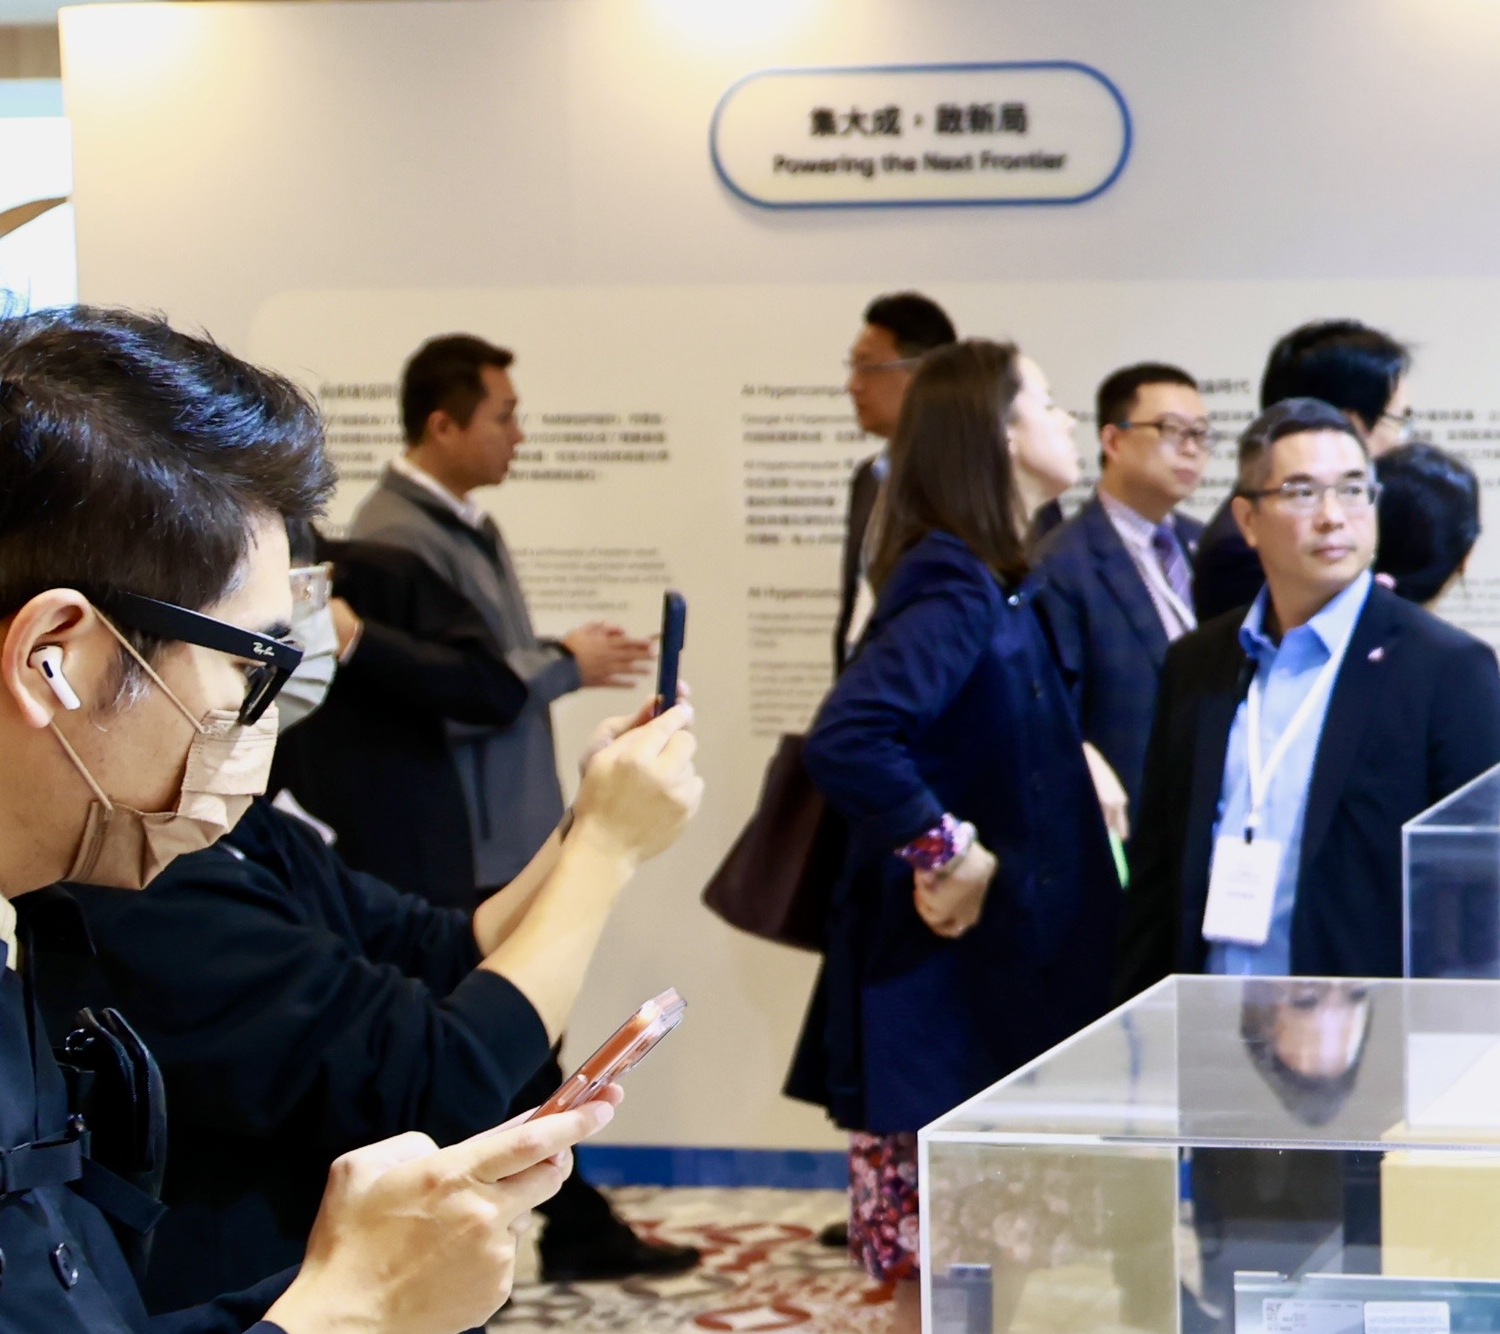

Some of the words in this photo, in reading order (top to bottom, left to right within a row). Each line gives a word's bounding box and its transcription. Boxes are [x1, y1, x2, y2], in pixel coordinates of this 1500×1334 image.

[772, 152, 875, 179] Powering
[880, 150, 917, 173] the
[921, 150, 973, 171] Next
[978, 149, 1067, 170] Frontier
